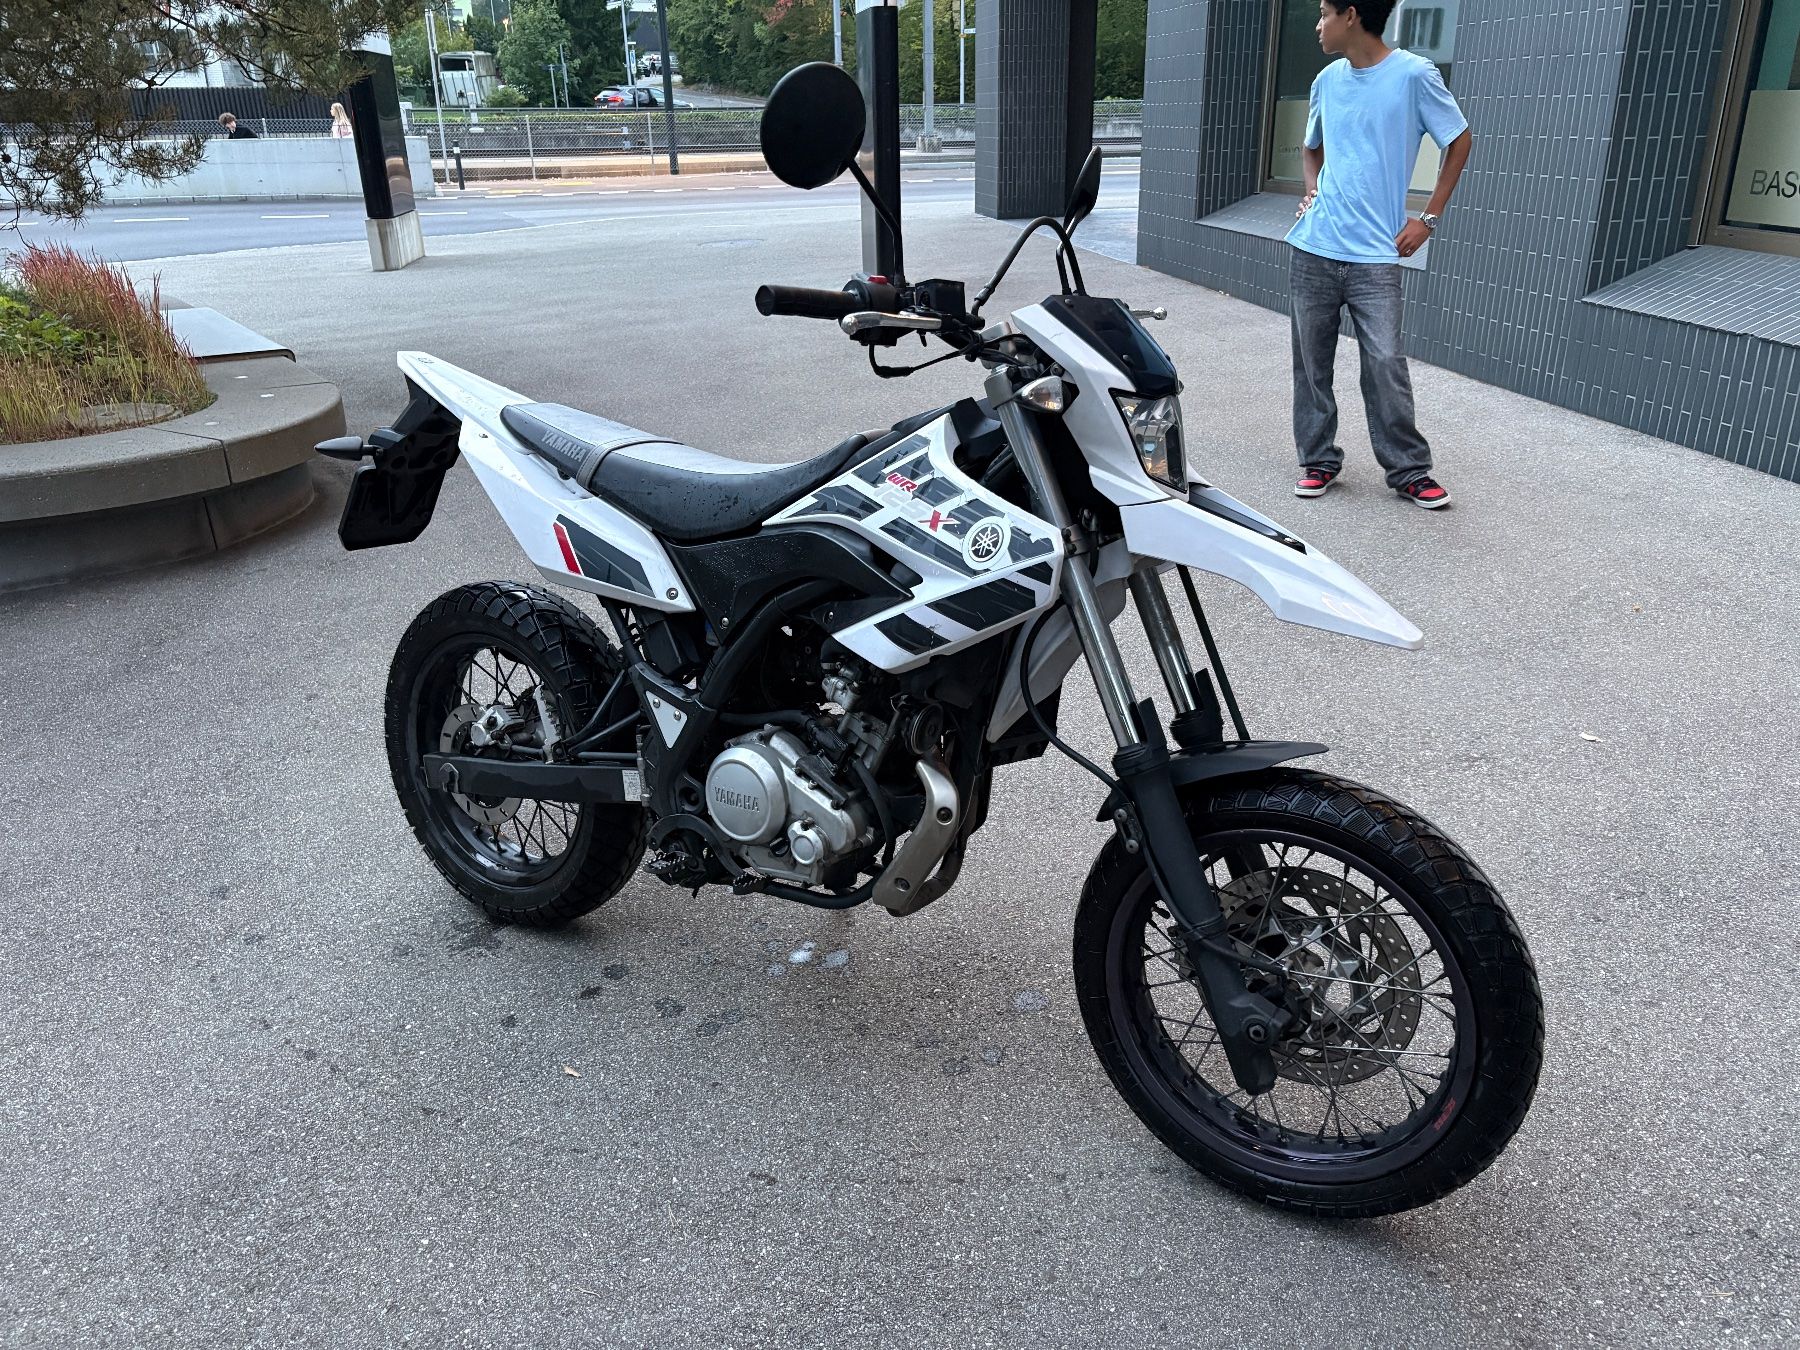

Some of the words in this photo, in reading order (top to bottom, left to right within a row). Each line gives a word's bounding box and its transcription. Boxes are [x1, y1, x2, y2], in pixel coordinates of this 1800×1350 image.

[1750, 170, 1800, 198] BAS
[541, 430, 587, 462] YAMAHA
[885, 472, 918, 493] WR
[918, 509, 957, 533] X
[714, 786, 760, 812] YAMAHA
